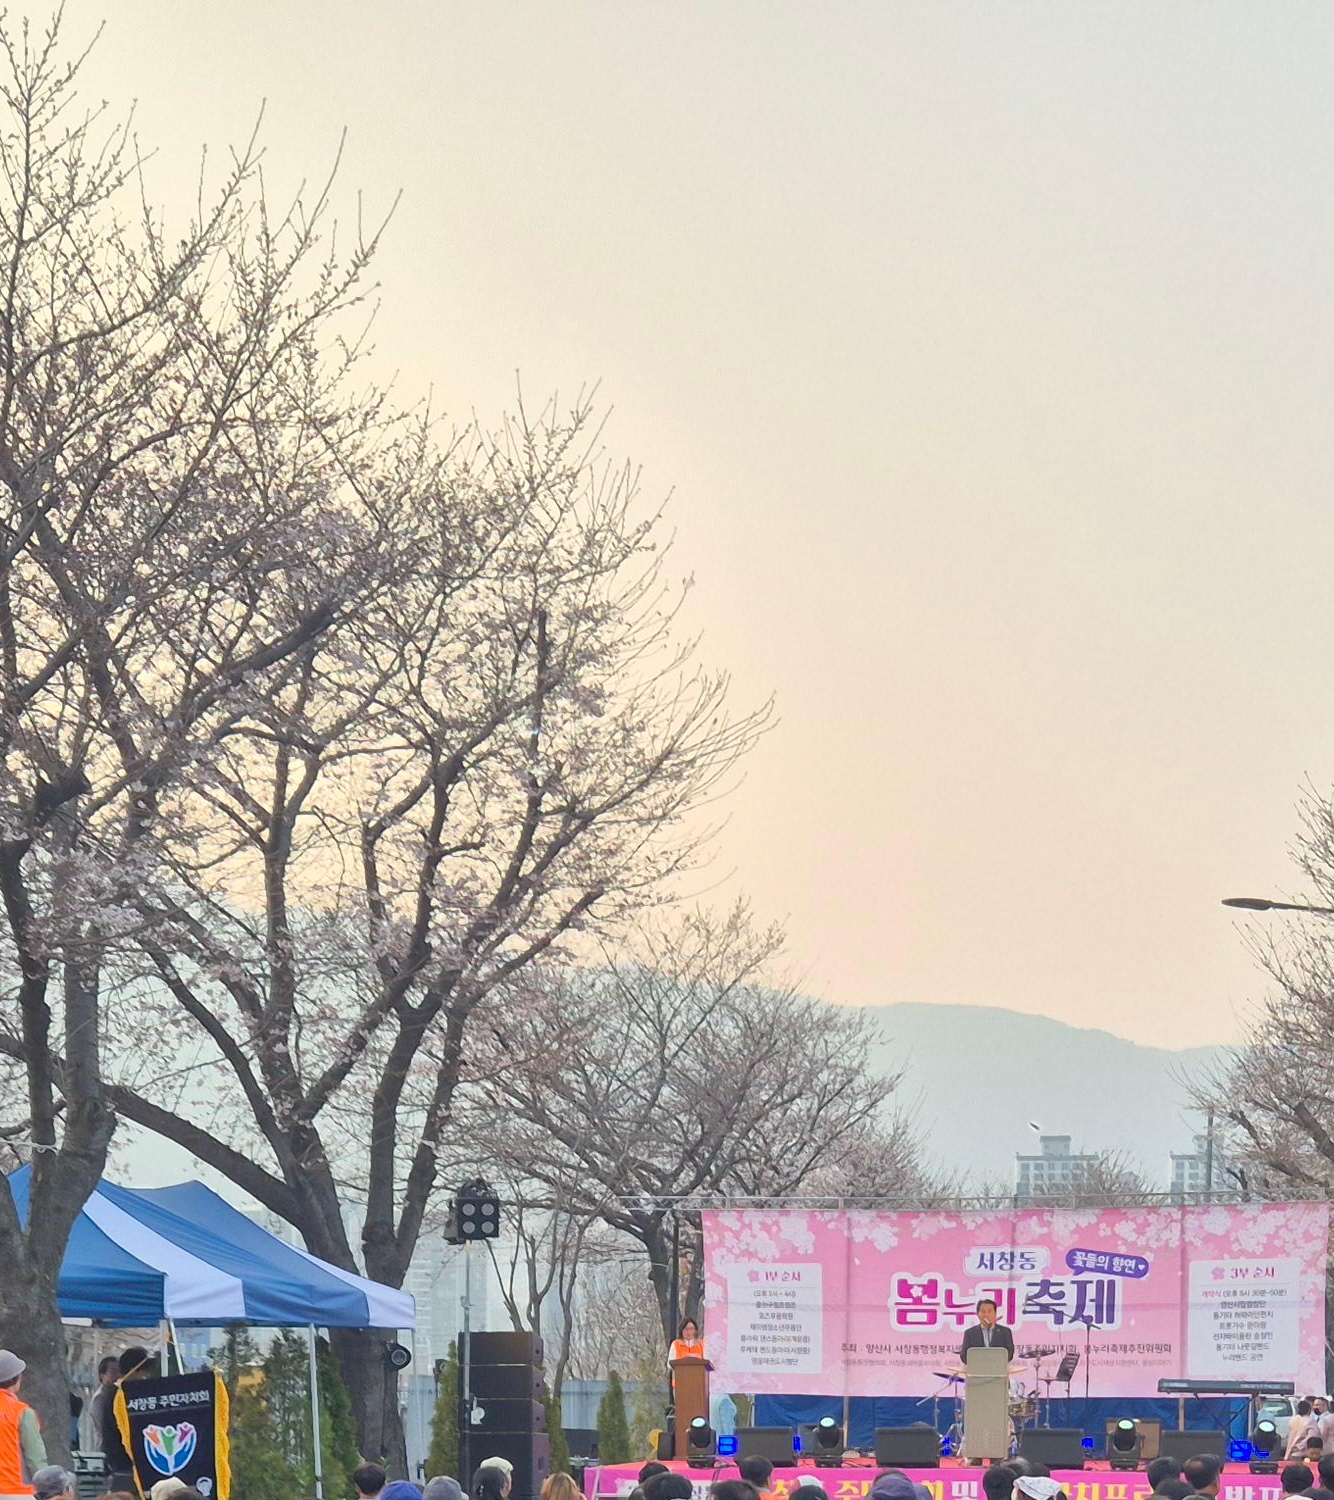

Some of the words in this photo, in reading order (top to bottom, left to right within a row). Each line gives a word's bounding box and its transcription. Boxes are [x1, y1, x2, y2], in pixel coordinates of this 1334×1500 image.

[976, 1251, 1037, 1272] 서창동
[1073, 1250, 1109, 1270] 꽃들의
[1112, 1256, 1136, 1274] 향연
[1230, 1267, 1249, 1279] 3부
[1253, 1266, 1275, 1278] 순서
[867, 1343, 892, 1354] 양산시
